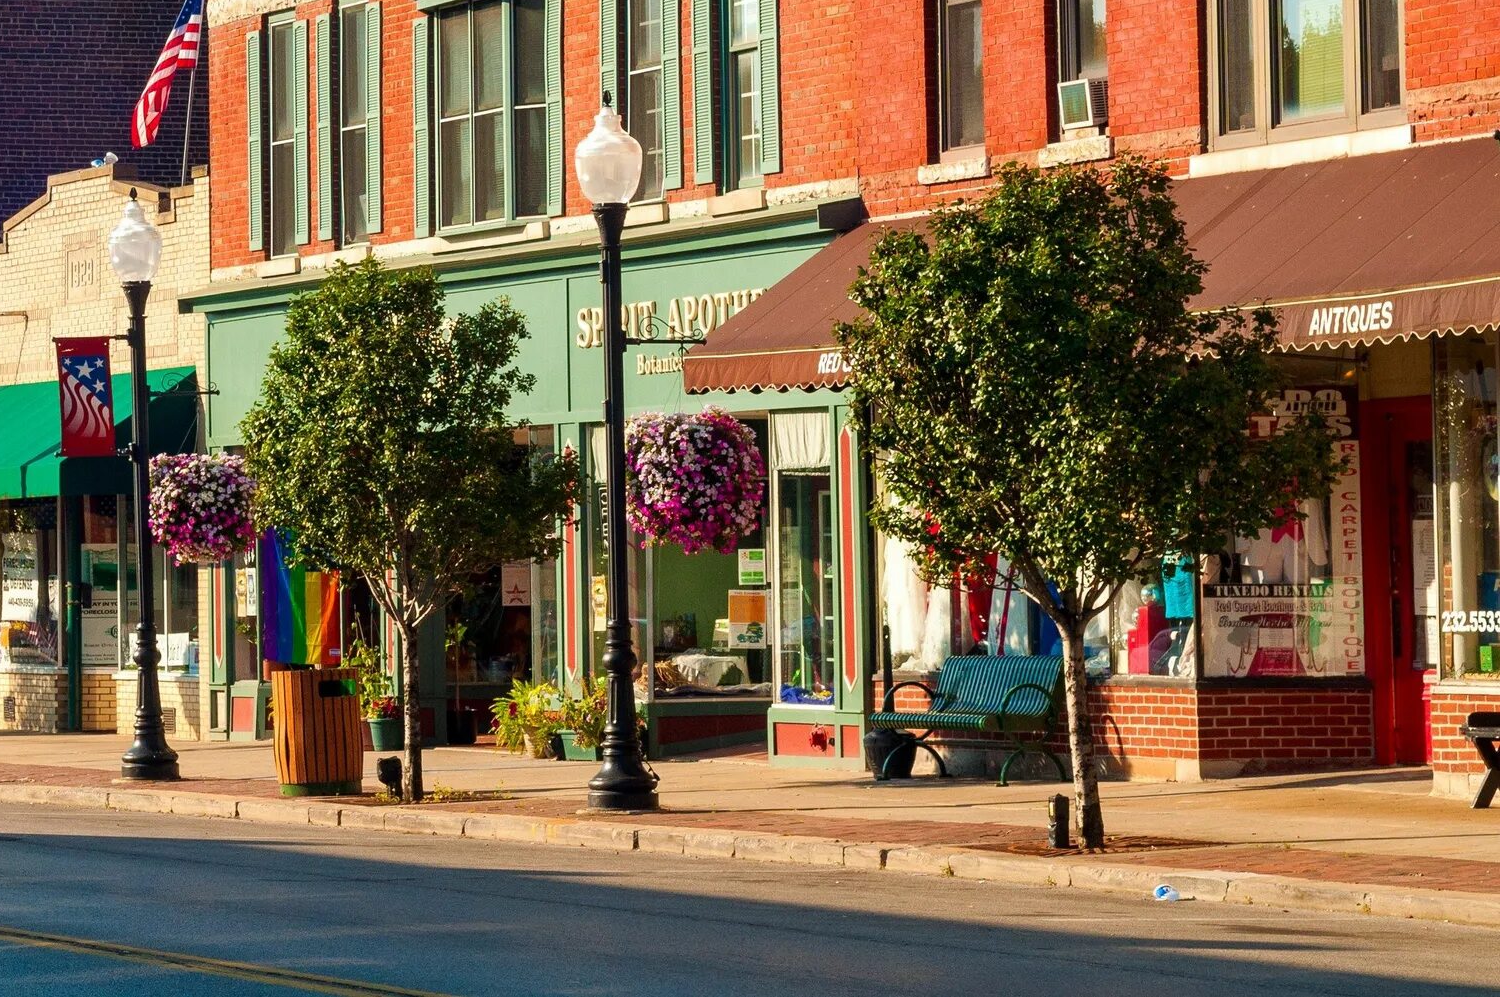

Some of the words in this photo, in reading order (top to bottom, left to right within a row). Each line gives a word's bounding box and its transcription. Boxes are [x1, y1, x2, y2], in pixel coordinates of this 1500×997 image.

[1308, 301, 1393, 336] ANTIQUES
[818, 352, 842, 374] RED
[1340, 492, 1359, 561] CARPET
[1214, 585, 1270, 597] TUXEDO
[1274, 585, 1333, 596] RENTALS
[1215, 601, 1231, 612] Red
[1234, 601, 1261, 614] Carpet
[1342, 576, 1364, 669] BOUTIQUE
[1441, 610, 1500, 633] 232.5533
